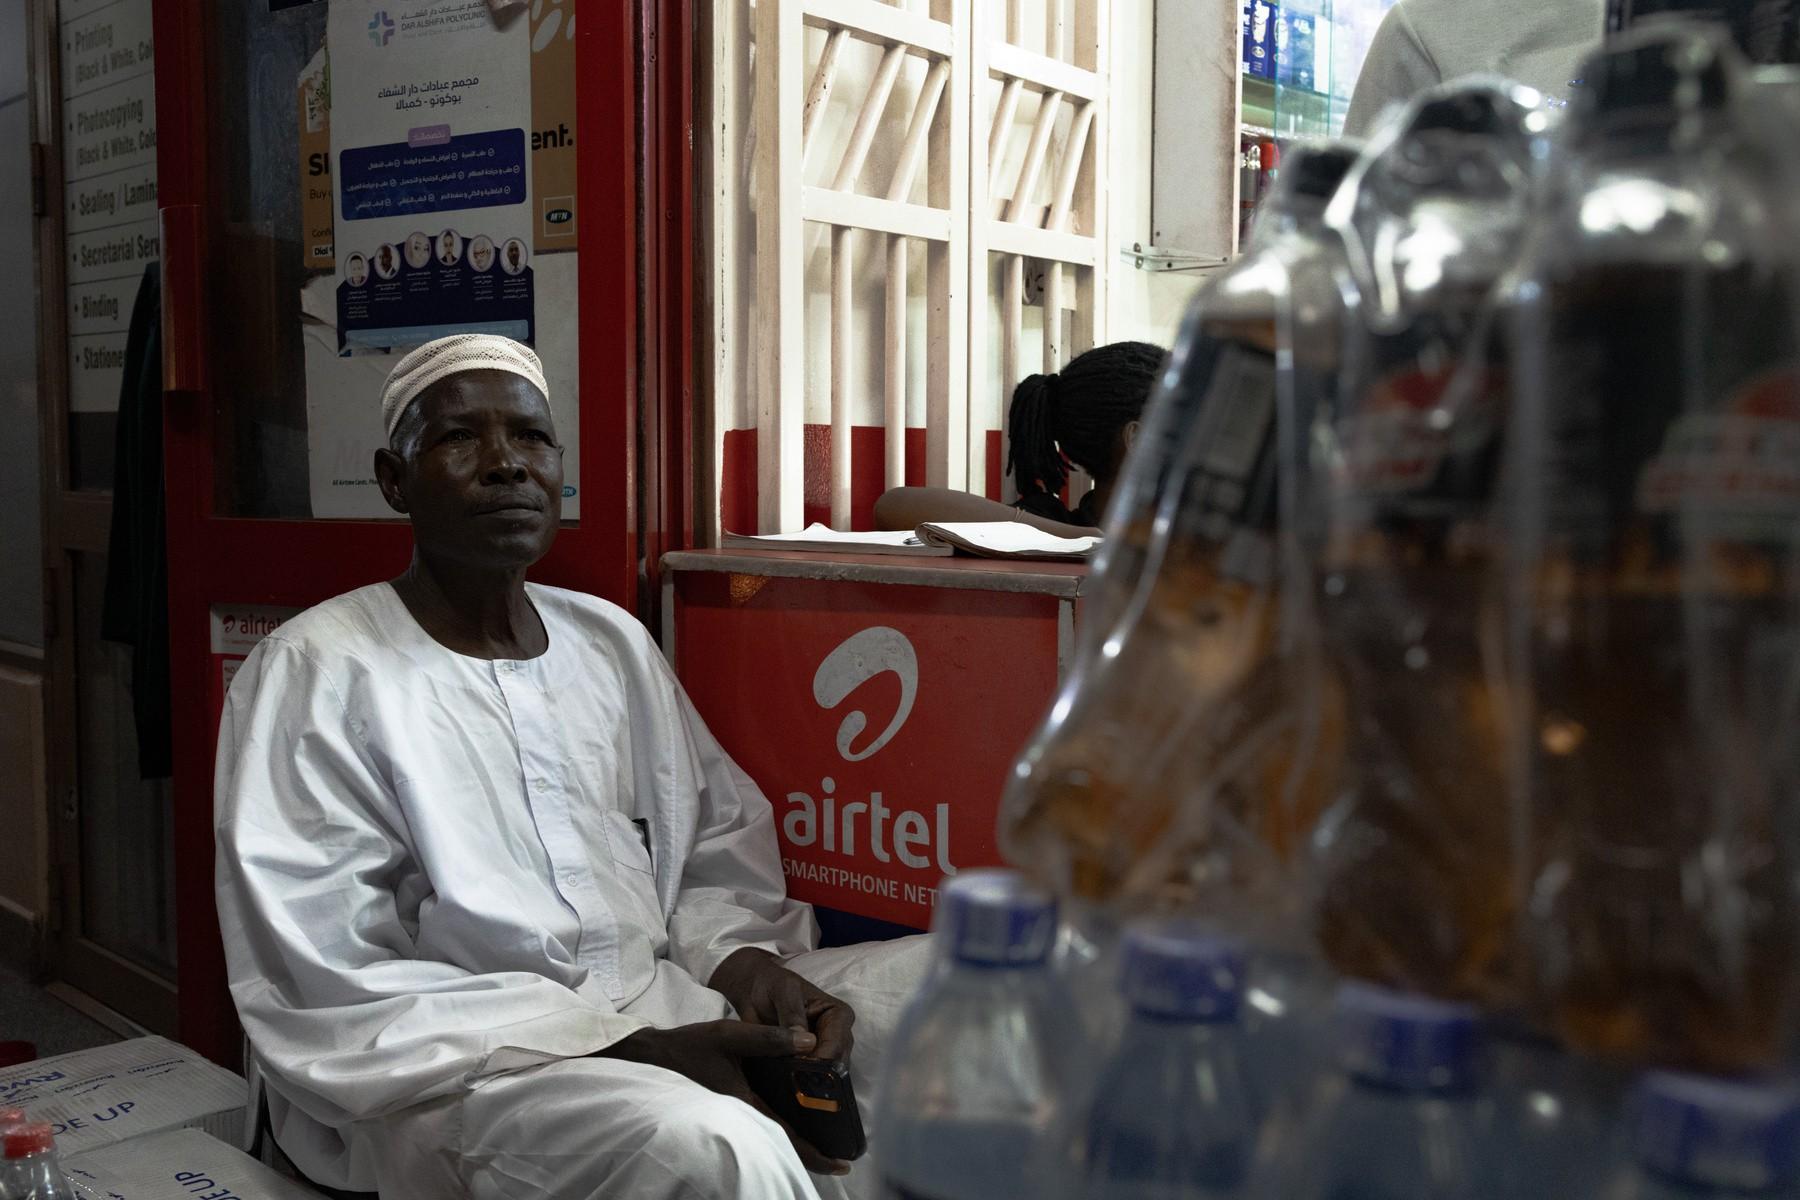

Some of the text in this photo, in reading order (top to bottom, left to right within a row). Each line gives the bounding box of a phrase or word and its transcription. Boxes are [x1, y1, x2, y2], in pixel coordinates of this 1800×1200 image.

[401, 21, 416, 31] DAR
[417, 17, 445, 28] ALSHIFA
[446, 10, 486, 24] POLYCLINIC
[75, 24, 113, 55] Printing
[378, 77, 479, 99] مجمع عيادات دار الشفاء
[77, 98, 143, 136] Photocopying
[396, 97, 422, 111] كمبالا
[79, 189, 115, 216] Sealing
[81, 236, 134, 268] Secretarial
[82, 294, 118, 321] Binding
[783, 776, 957, 876] airtel
[782, 857, 899, 899] SMARTPHONE
[93, 1101, 135, 1122] UP
[175, 1171, 215, 1193] UP
